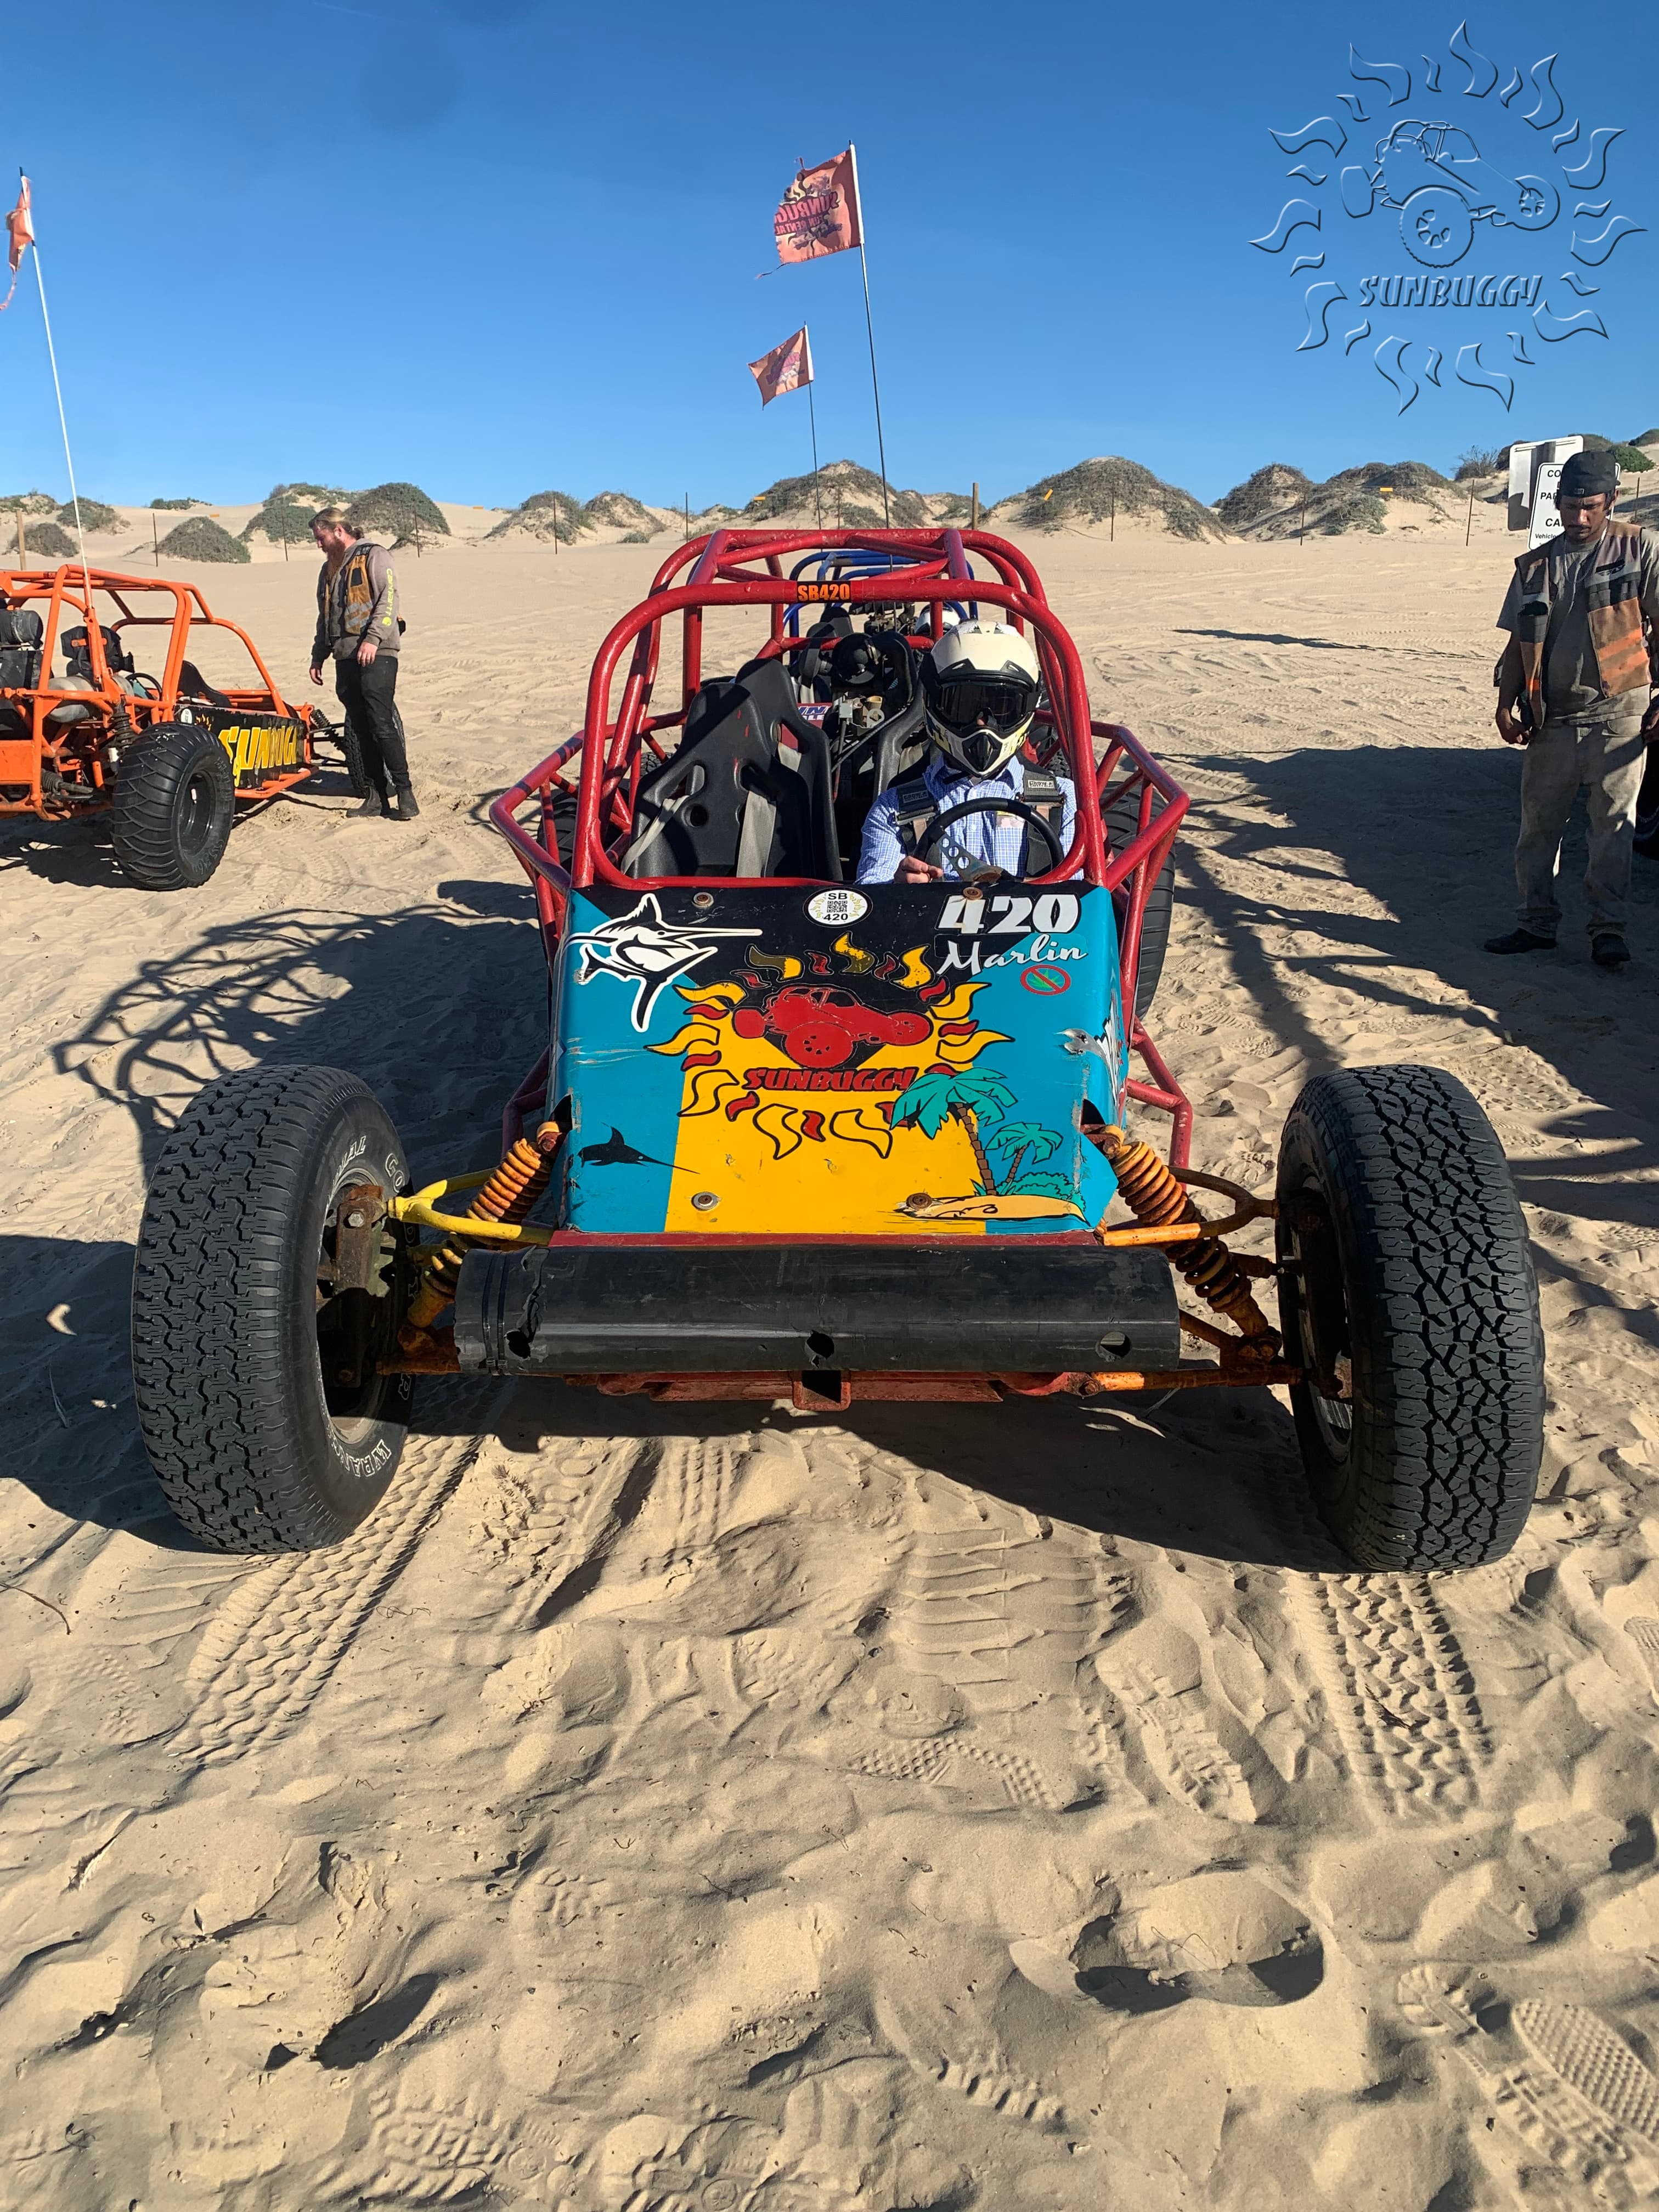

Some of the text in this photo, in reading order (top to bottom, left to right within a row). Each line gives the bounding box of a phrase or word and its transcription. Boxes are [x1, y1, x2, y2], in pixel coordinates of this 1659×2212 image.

[1547, 470, 1561, 478] CO
[798, 584, 850, 601] SB420
[938, 894, 1079, 934] 420
[936, 934, 1089, 975] Marlin
[742, 1067, 918, 1091] SUNBUGGY
